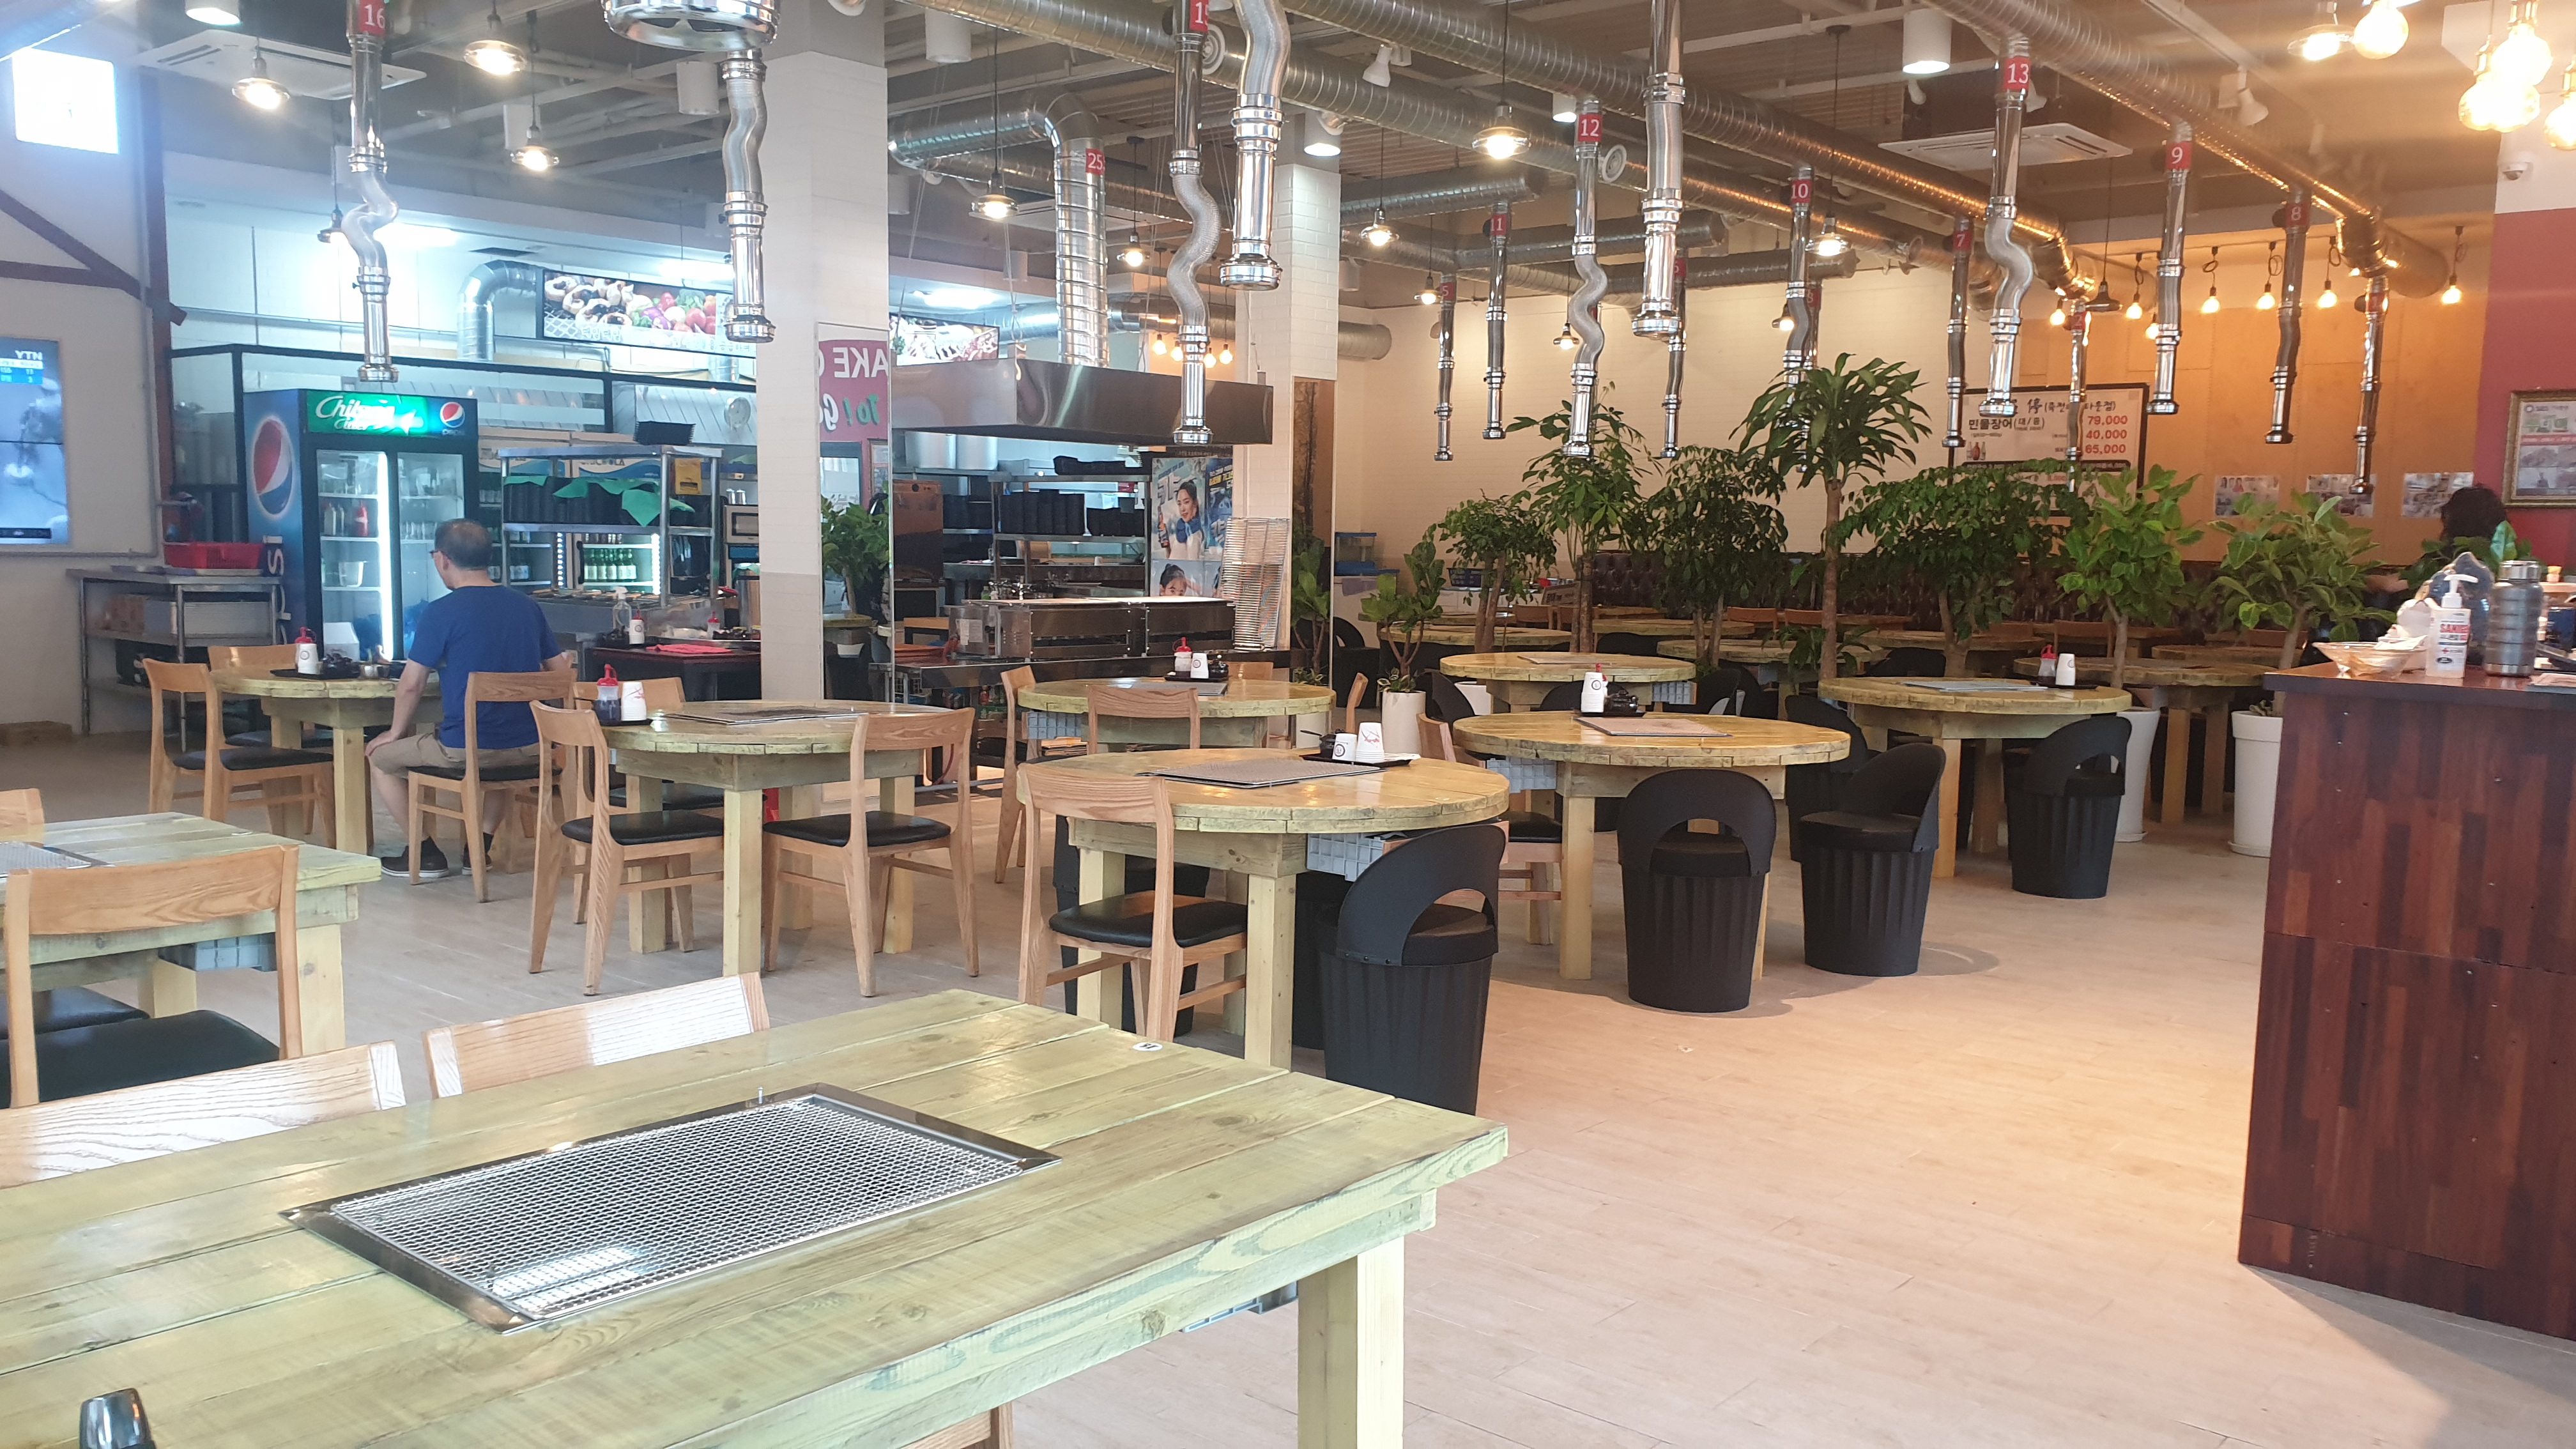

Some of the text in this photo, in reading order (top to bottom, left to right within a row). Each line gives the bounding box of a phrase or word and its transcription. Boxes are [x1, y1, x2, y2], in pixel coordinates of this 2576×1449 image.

[364, 4, 385, 29] 16
[2007, 63, 2029, 84] 13
[1581, 119, 1599, 137] 12
[1087, 153, 1103, 170] 25
[2172, 146, 2183, 164] 9
[1791, 183, 1809, 199] 10
[2291, 206, 2301, 220] 8
[1491, 218, 1503, 231] 11
[1957, 233, 1966, 247] 7
[1442, 285, 1450, 296] 5
[15, 350, 43, 360] YTN
